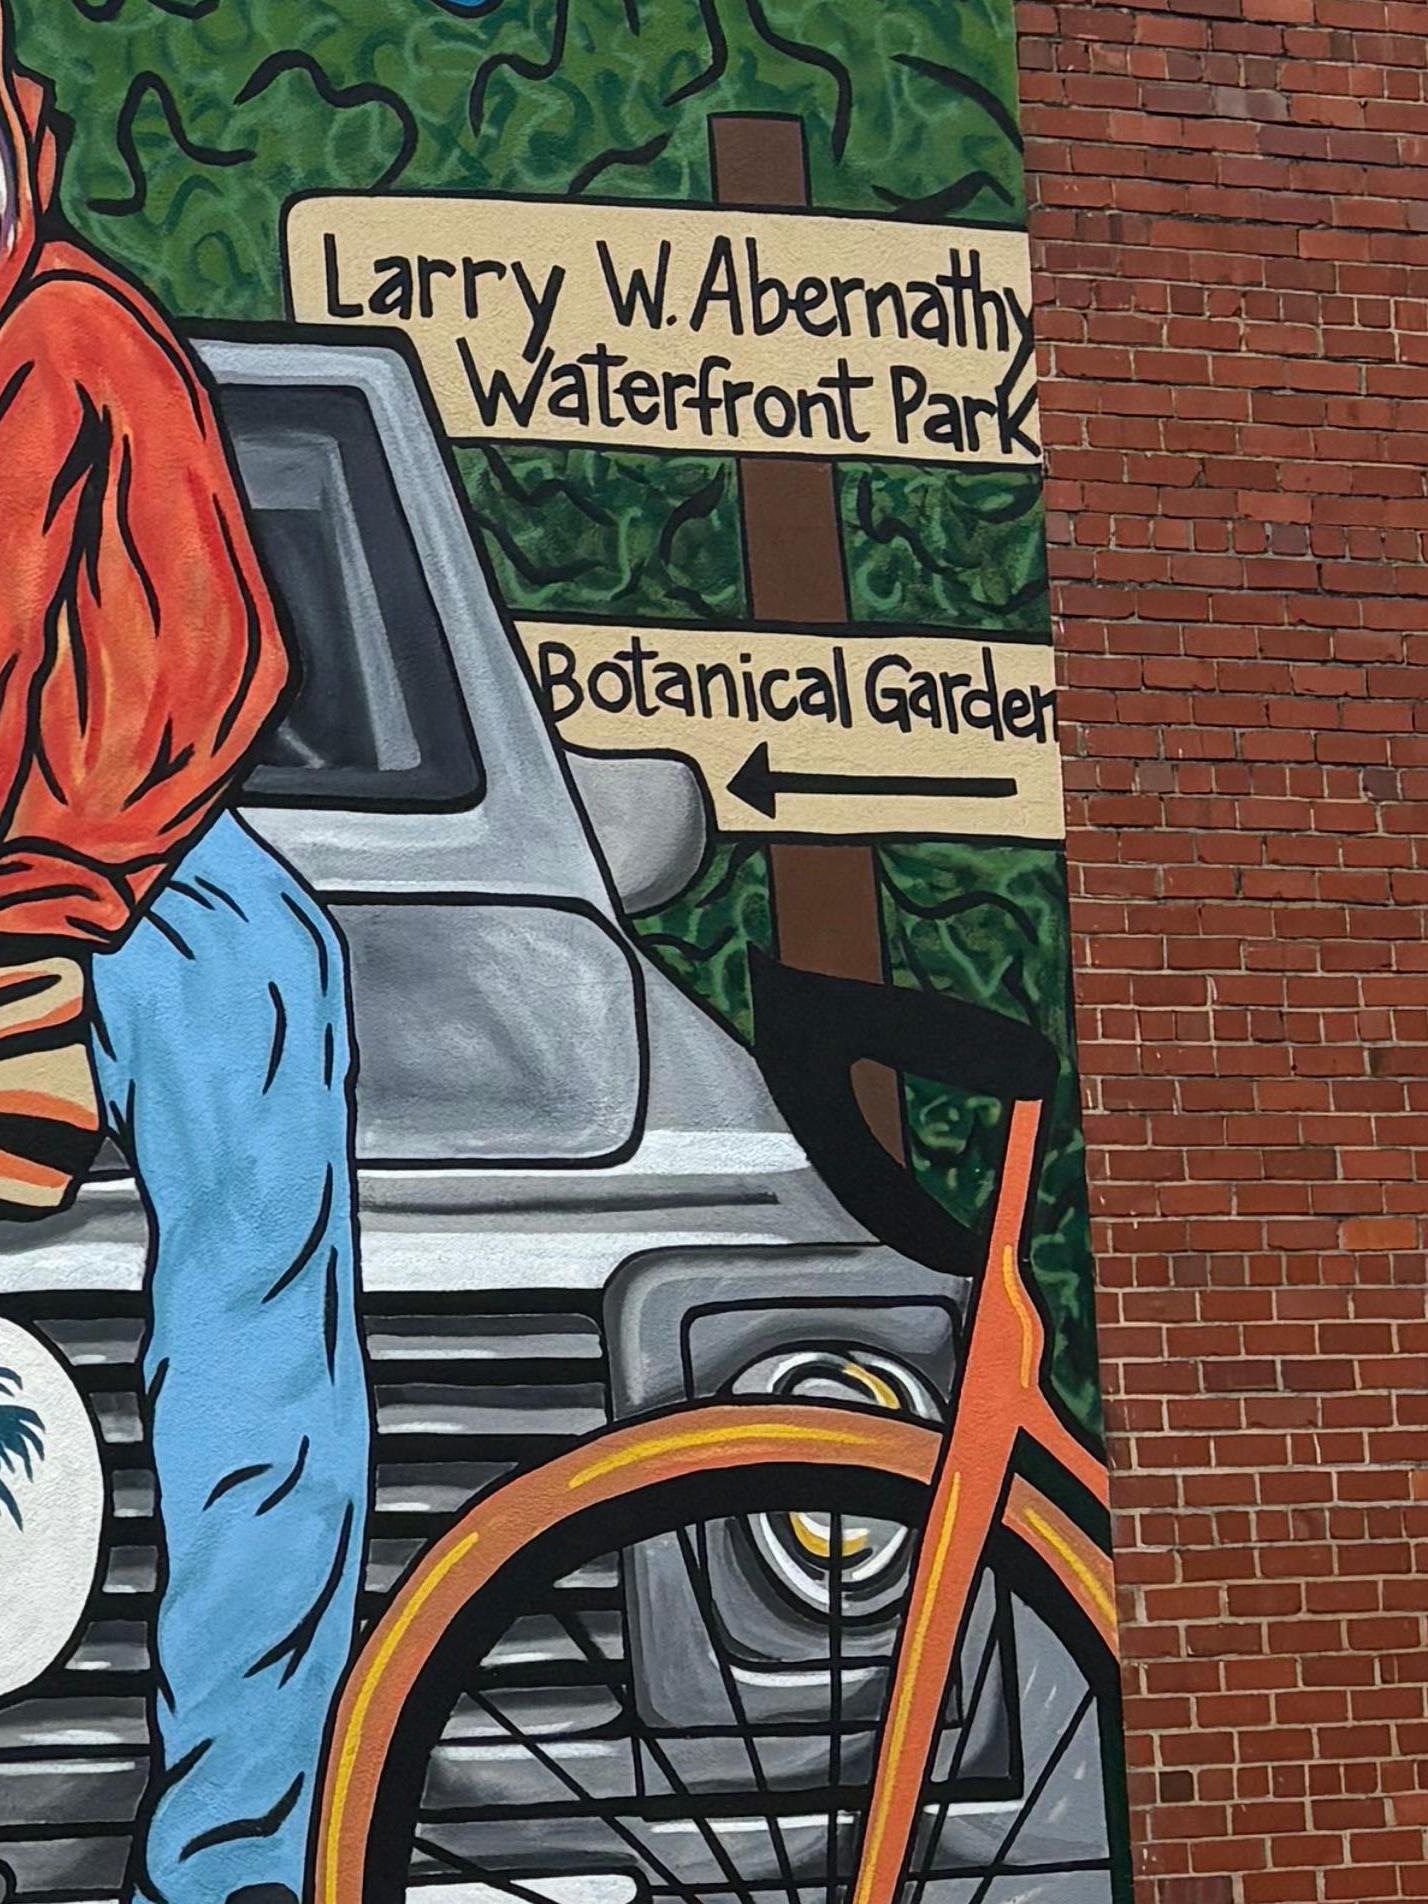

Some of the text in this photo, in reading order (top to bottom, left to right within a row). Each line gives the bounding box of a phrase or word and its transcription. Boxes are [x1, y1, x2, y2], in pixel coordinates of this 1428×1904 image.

[323, 233, 1036, 390] Larry W. Abernathy
[456, 337, 1042, 457] Waterfront Park
[538, 637, 1059, 744] Botanical Garden
